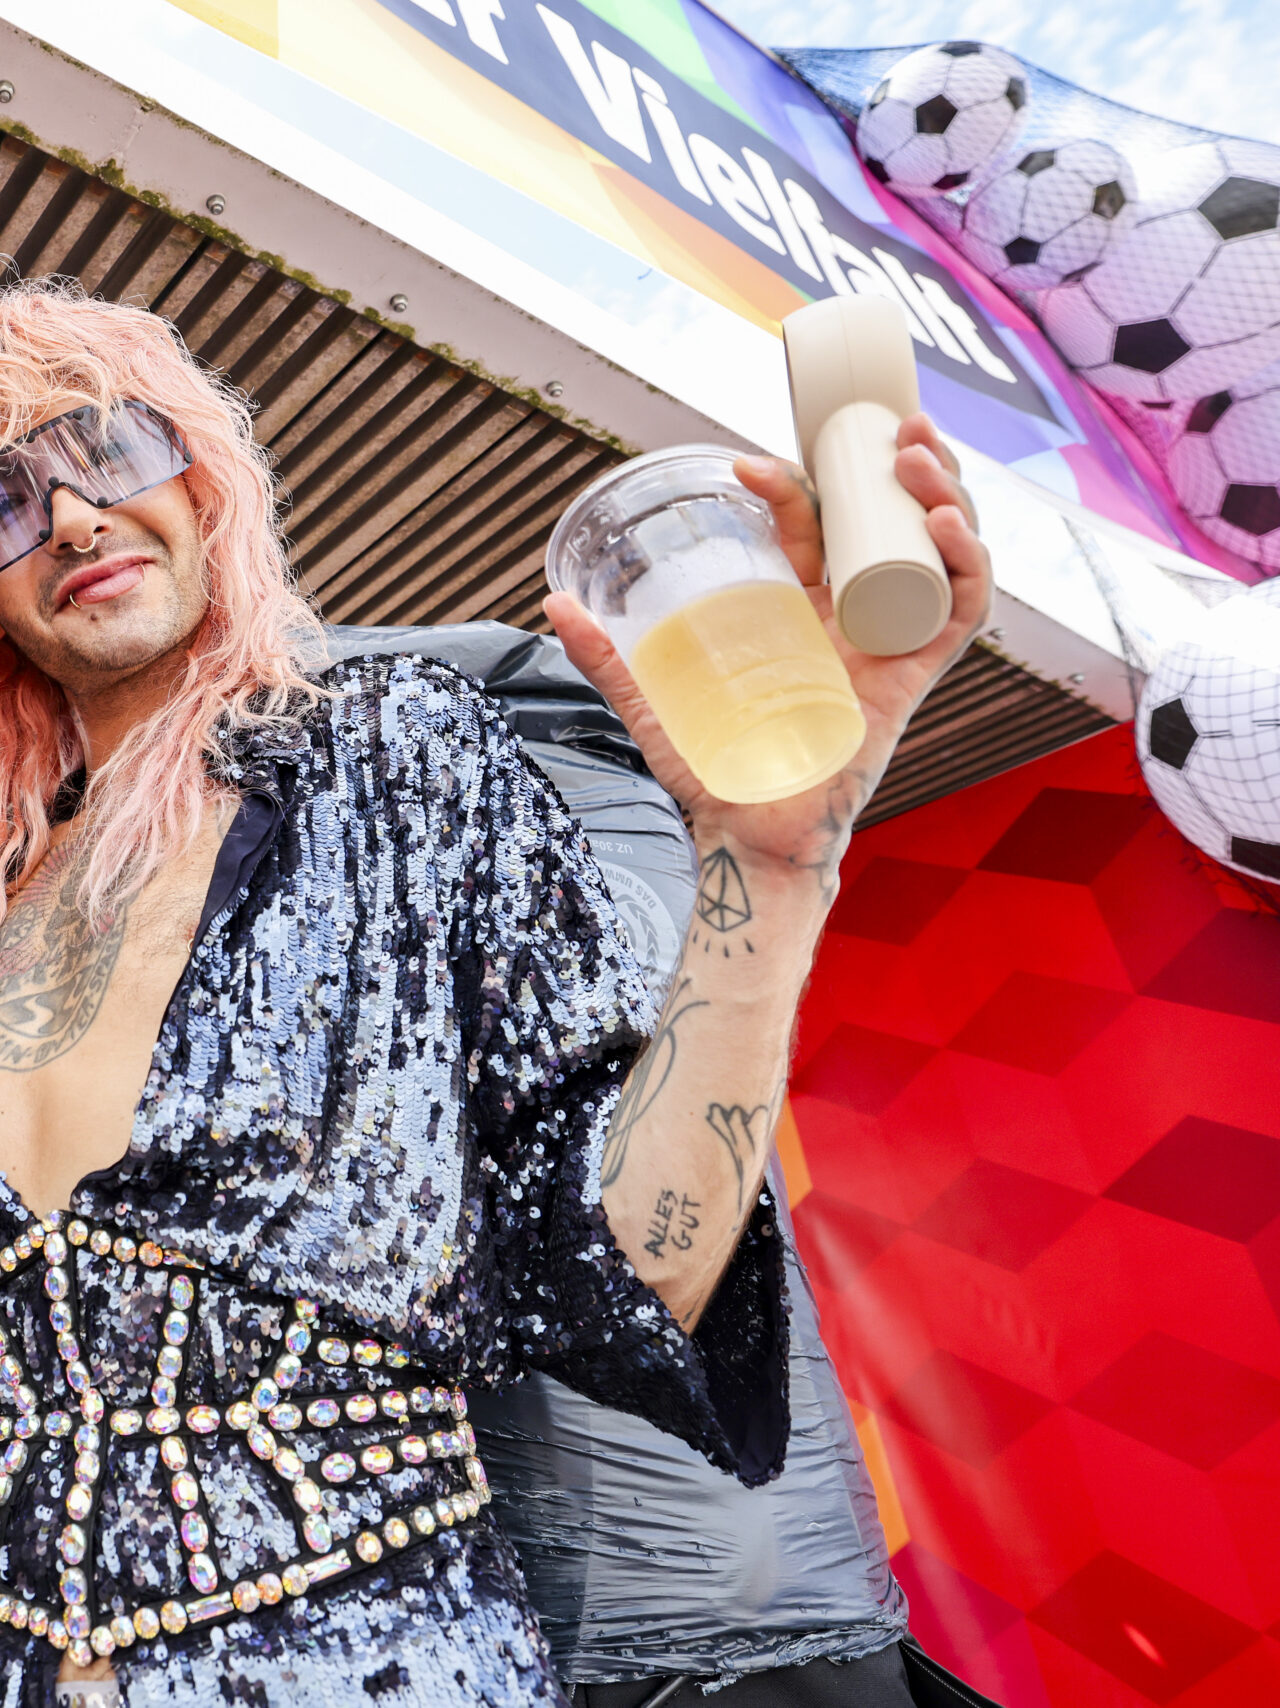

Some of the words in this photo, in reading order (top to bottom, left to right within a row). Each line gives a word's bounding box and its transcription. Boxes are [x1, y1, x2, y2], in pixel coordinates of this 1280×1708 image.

[535, 2, 1018, 384] Vielfalt
[616, 842, 634, 855] UZ
[636, 886, 657, 909] DAS
[643, 1189, 678, 1260] ALLES
[670, 1193, 701, 1250] GUT
